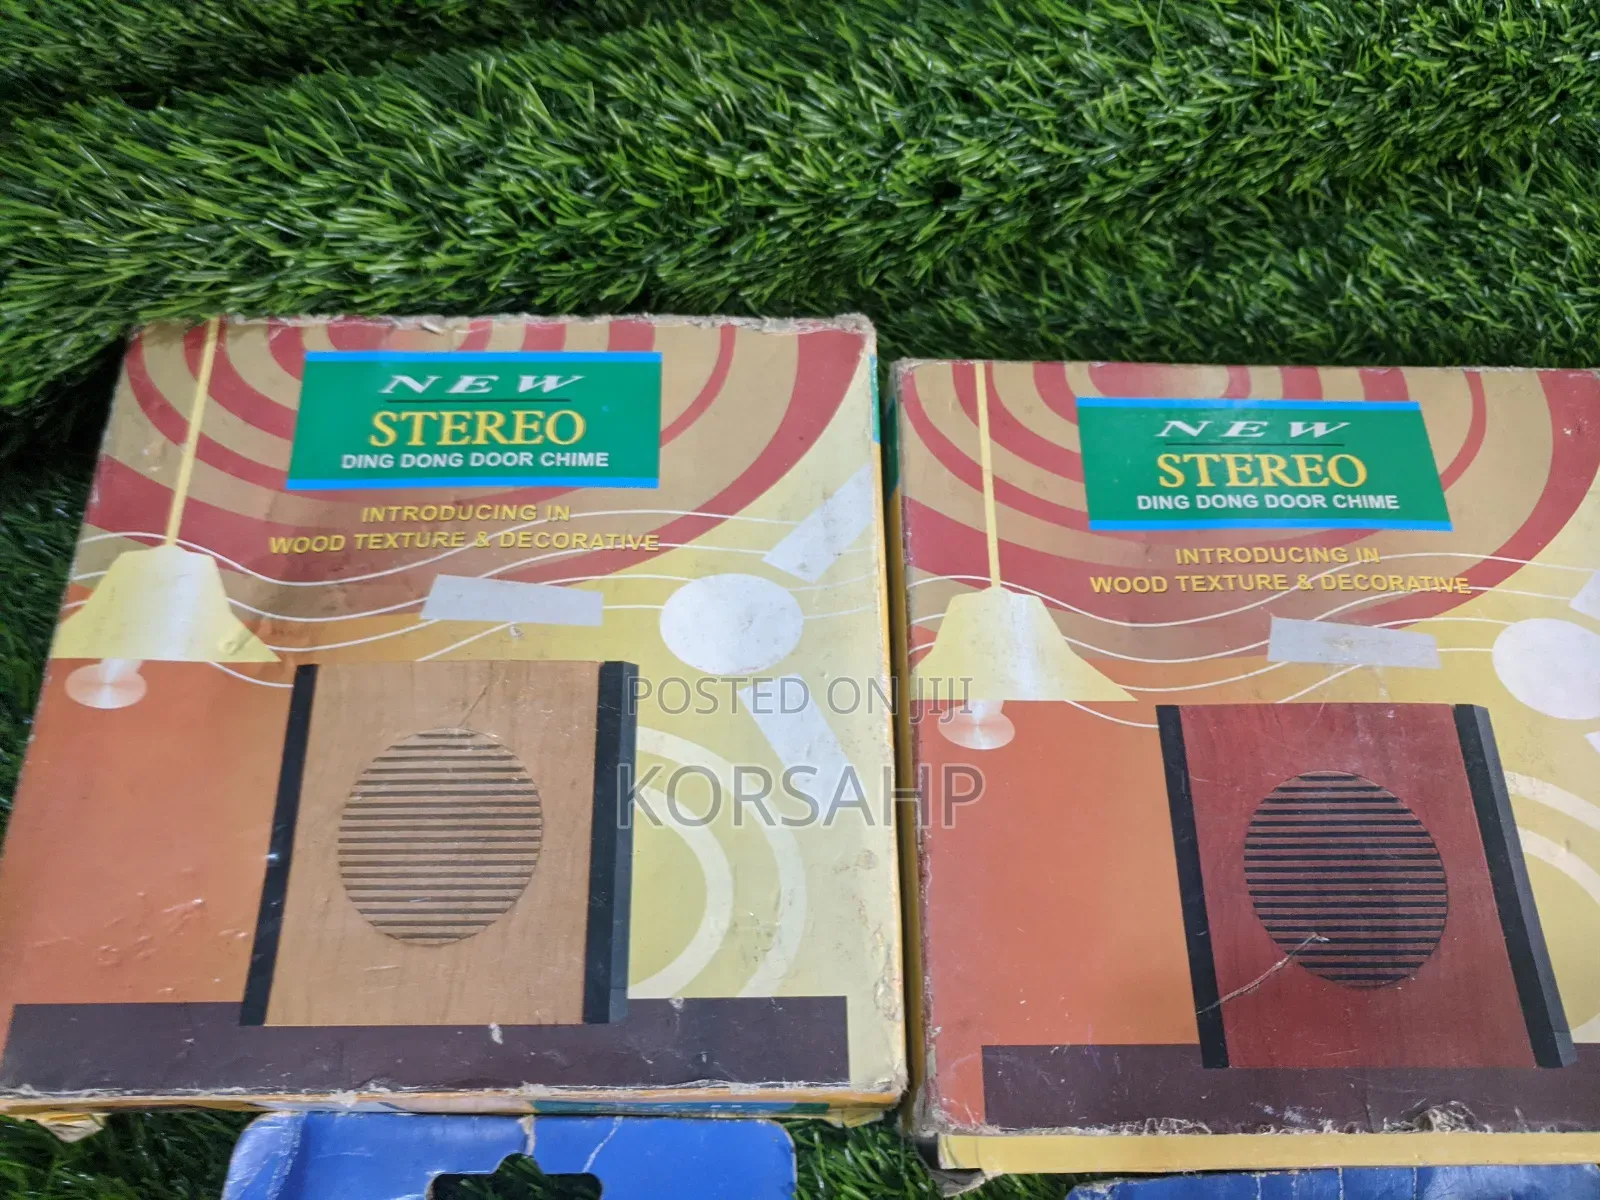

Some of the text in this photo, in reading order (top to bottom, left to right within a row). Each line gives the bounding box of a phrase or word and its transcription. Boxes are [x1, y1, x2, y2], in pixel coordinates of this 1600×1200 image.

[378, 375, 586, 394] NEW
[369, 410, 586, 447] STEREO
[1154, 420, 1350, 438] NEW
[341, 452, 609, 469] DING DONG DOOR CHIME
[1156, 453, 1368, 488] STEREO
[1137, 494, 1400, 510] DING DONG DOOR CHIME
[361, 505, 571, 523] INTRODUCING IN
[269, 532, 660, 554] WOOD TEXTURE & DECORATIVE
[1175, 547, 1381, 566] INTRODUCING IN
[1090, 574, 1472, 595] WOOD TEXTURE & DECORATIVE
